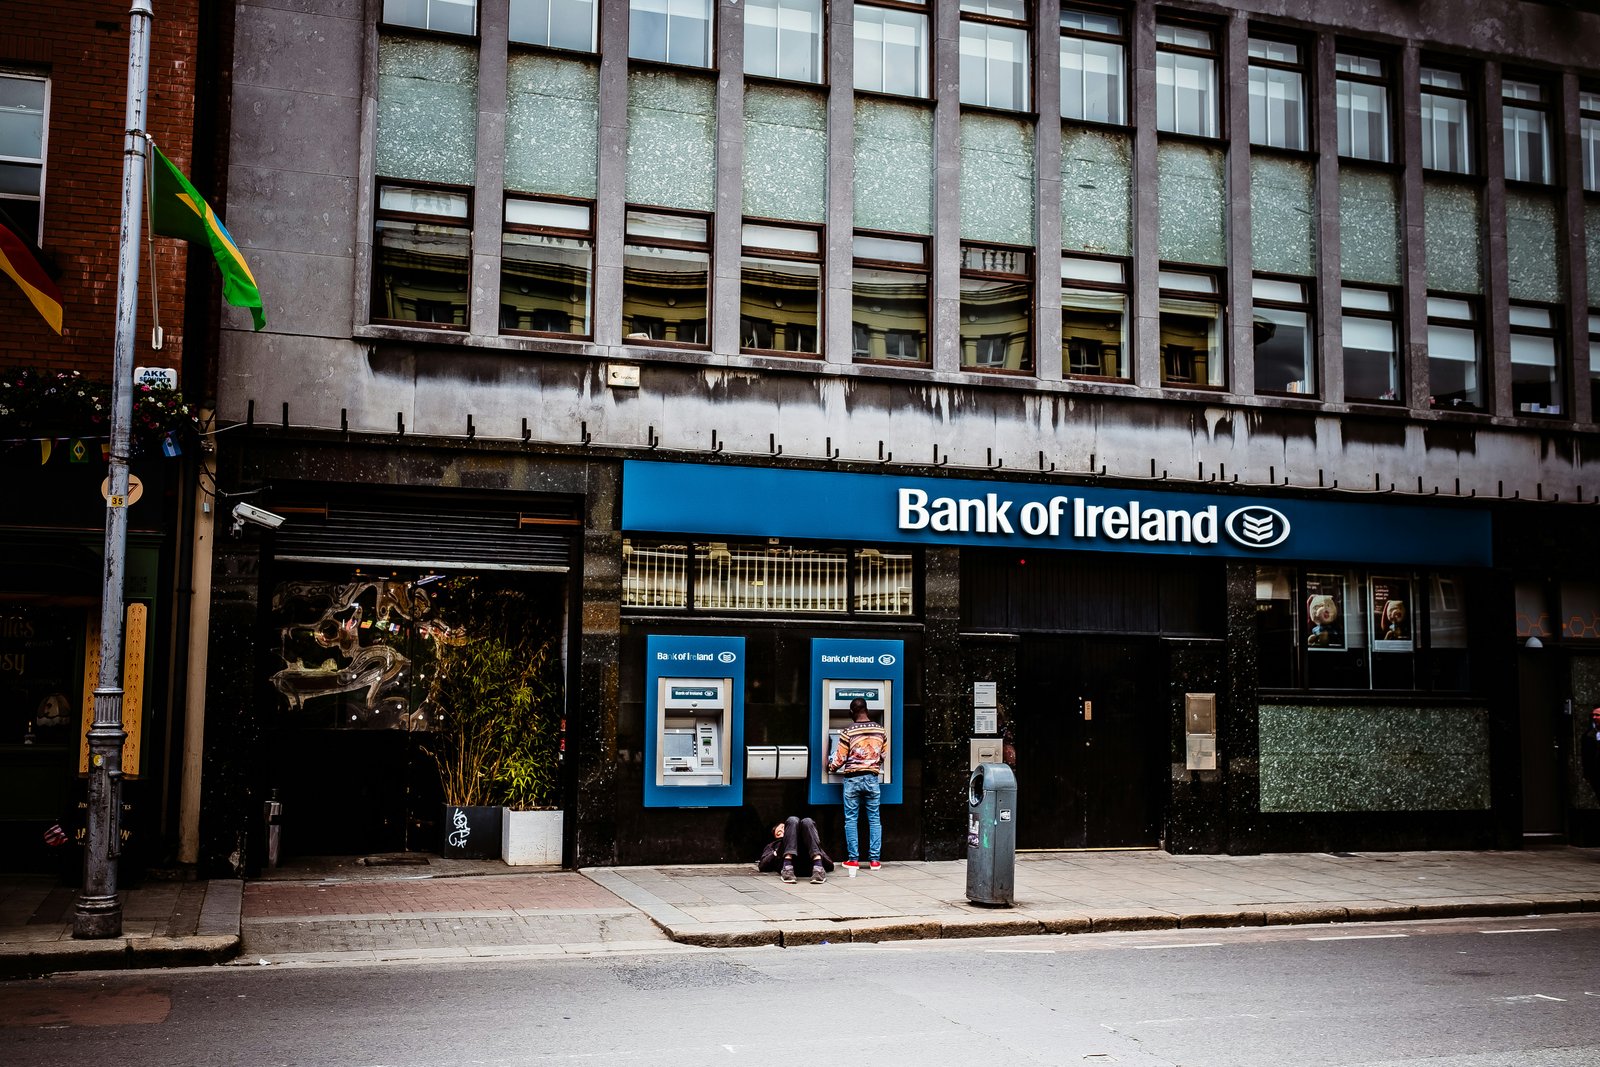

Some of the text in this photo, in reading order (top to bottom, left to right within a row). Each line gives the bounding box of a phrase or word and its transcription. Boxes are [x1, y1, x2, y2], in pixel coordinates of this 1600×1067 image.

[112, 497, 123, 505] 35
[898, 488, 1218, 544] Bank of Ireland
[678, 652, 687, 660] of
[841, 655, 849, 663] of
[849, 655, 874, 663] Ireland
